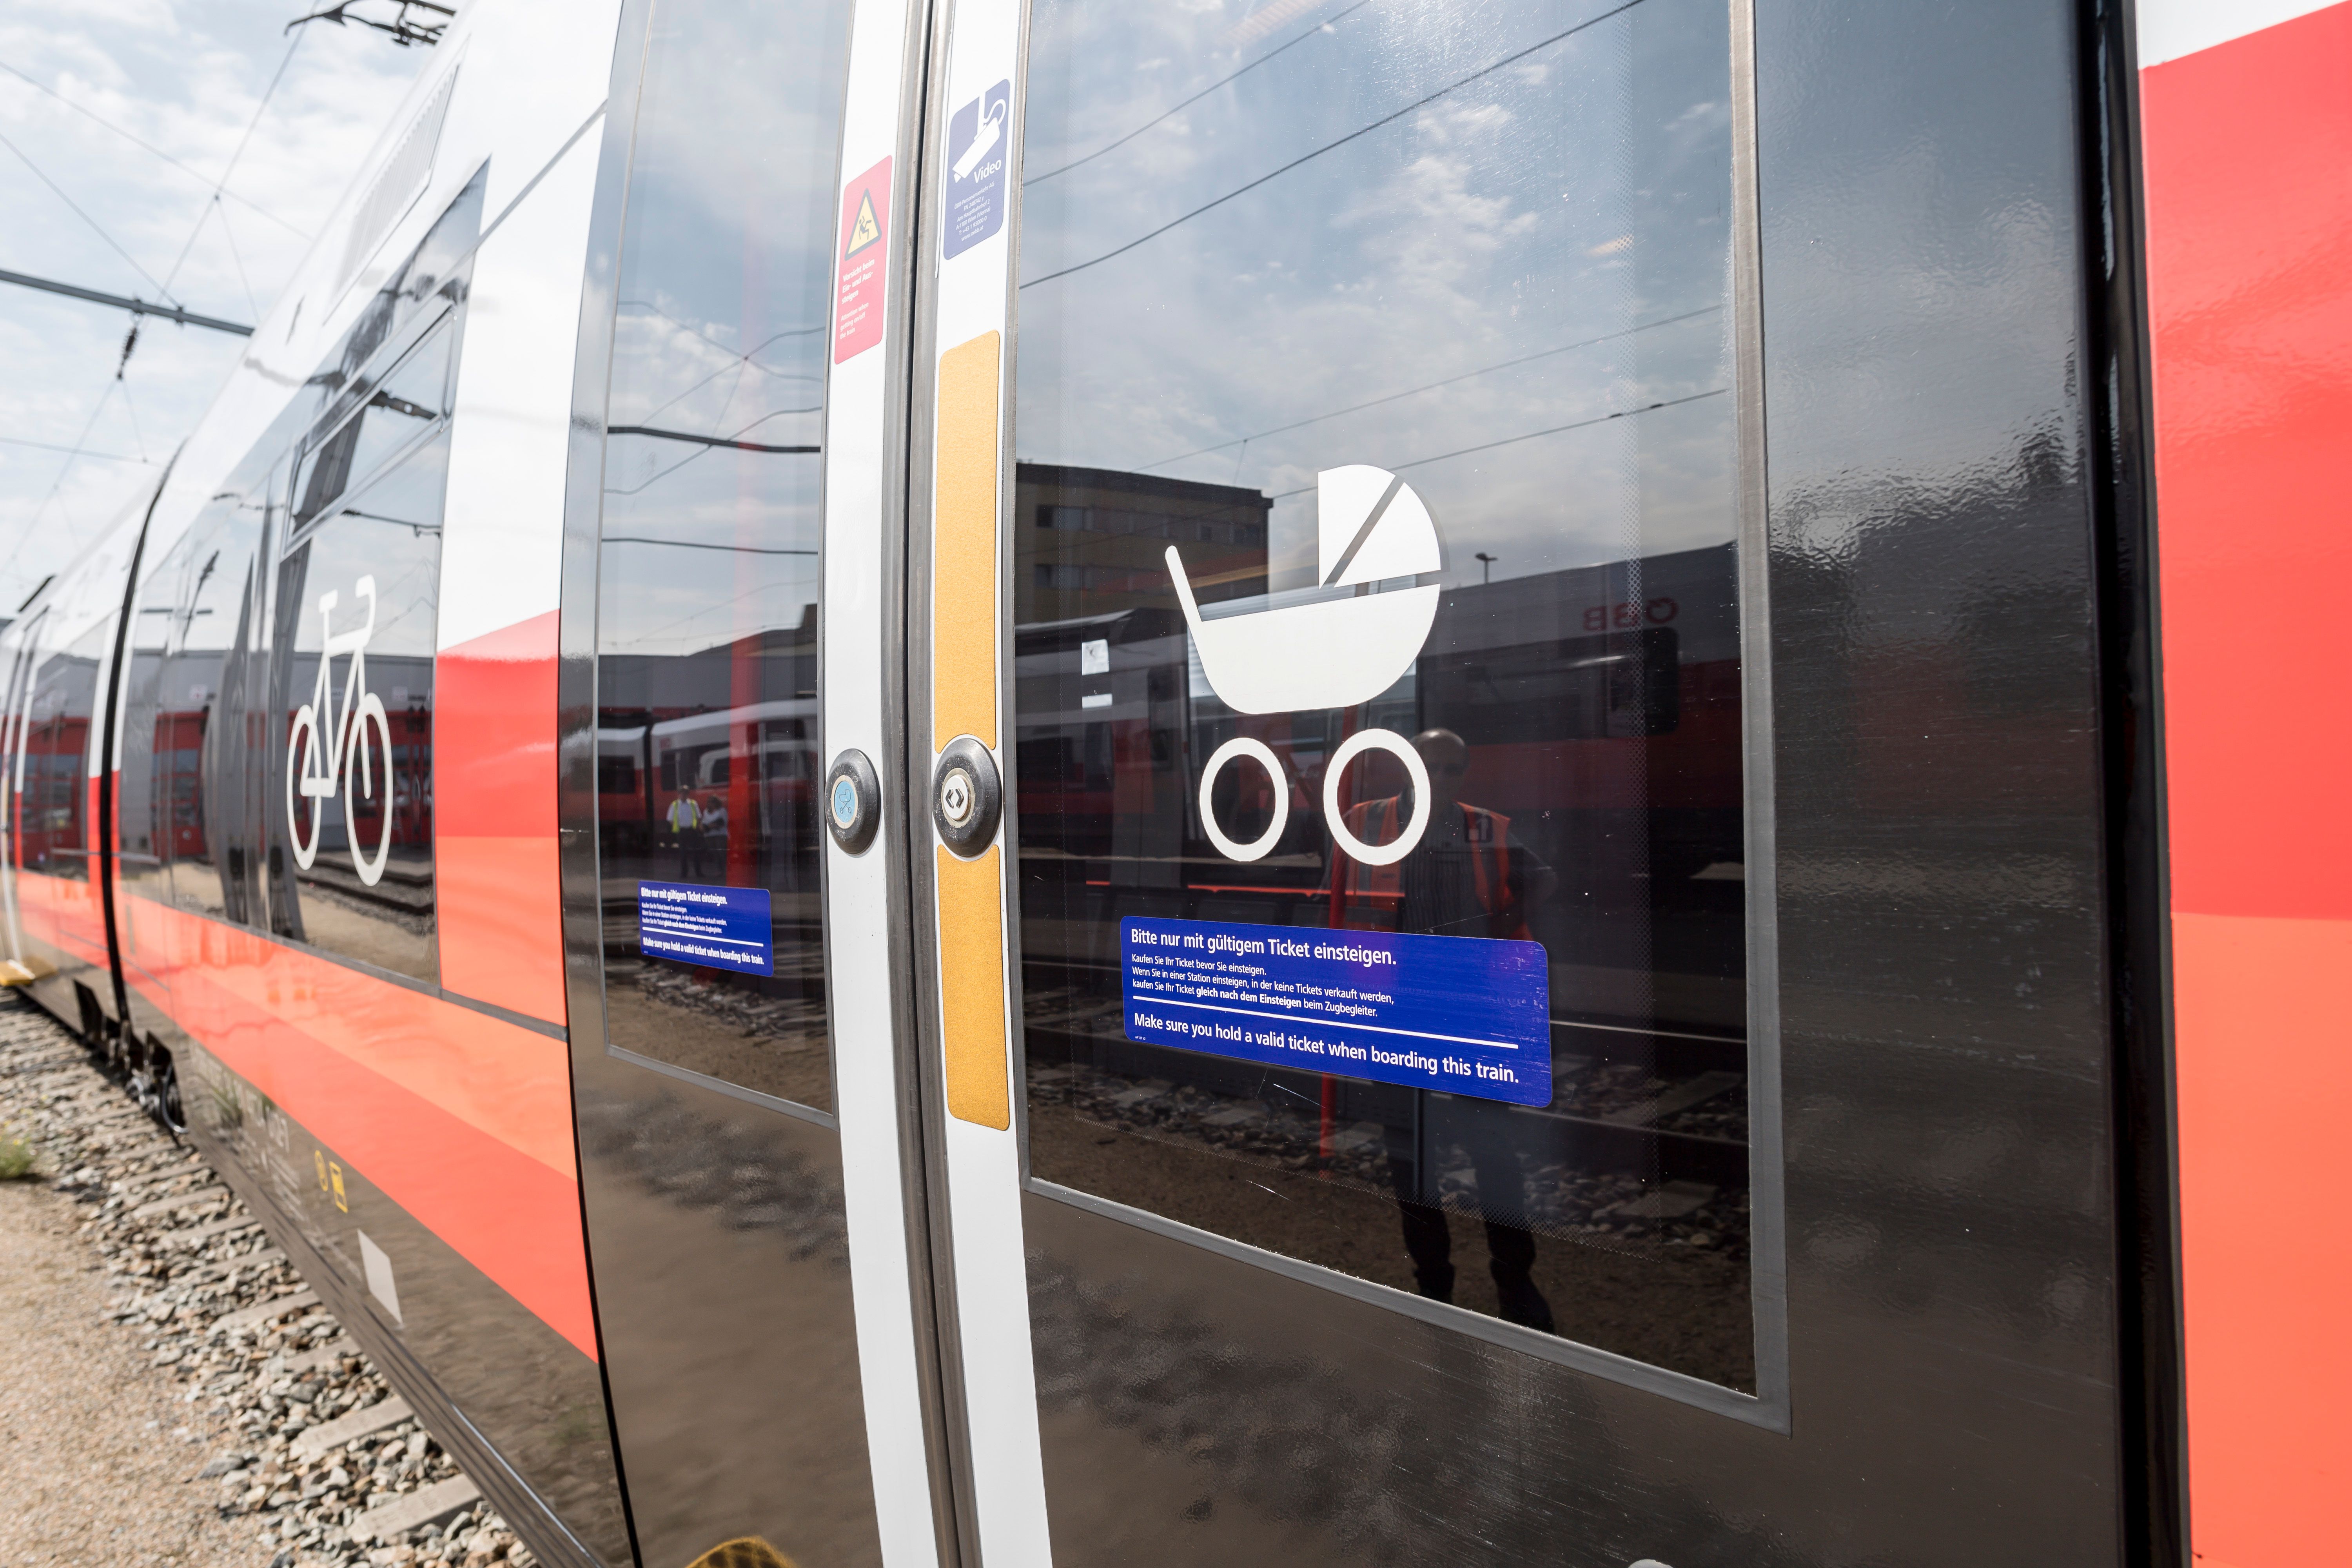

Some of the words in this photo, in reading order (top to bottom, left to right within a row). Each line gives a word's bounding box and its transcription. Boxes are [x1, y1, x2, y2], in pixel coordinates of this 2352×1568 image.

[974, 160, 1002, 183] Video
[843, 266, 862, 282] Vorsicht
[862, 259, 875, 270] beim
[842, 284, 851, 294] Ein-
[852, 275, 861, 287] und
[862, 271, 873, 282] Aus-
[842, 290, 859, 304] steigen
[841, 308, 858, 321] Attention
[858, 302, 869, 311] when
[840, 319, 853, 332] getting
[846, 327, 856, 336] train
[641, 887, 651, 897] Bitte
[667, 889, 686, 902] gültigem
[686, 891, 701, 902] Ticket
[701, 892, 728, 906] einsteigen.
[643, 937, 654, 947] Make
[662, 942, 671, 951] you
[671, 940, 680, 951] hold
[684, 944, 694, 954] valid
[694, 945, 707, 956] ticket
[707, 947, 720, 958] when
[720, 948, 741, 964] boarding
[741, 952, 751, 963] this
[751, 954, 764, 965] train.
[1131, 928, 1157, 945] Bitte
[1161, 934, 1181, 946] nur
[1184, 933, 1204, 949] mit
[1207, 934, 1264, 956] gültigem
[1267, 938, 1310, 958] Ticket
[1314, 942, 1396, 967] einsteigen.
[1132, 953, 1153, 964] Kaufen
[1154, 956, 1164, 965] Sie
[1165, 956, 1174, 966] Ihr
[1175, 957, 1195, 968] Ticket
[1196, 959, 1215, 970] bevor
[1216, 962, 1227, 971] Sie
[1229, 963, 1267, 976] einsteigen.
[1132, 966, 1150, 976] Wenn
[1151, 968, 1161, 978] Sie
[1162, 969, 1168, 978] in
[1169, 970, 1186, 980] einer
[1187, 972, 1210, 983] Station
[1212, 975, 1249, 989] einsteigen,
[1251, 978, 1258, 988] in
[1260, 979, 1272, 990] der
[1274, 980, 1294, 993] keine
[1295, 983, 1323, 996] Tickets
[1324, 987, 1358, 1000] verkauft
[1359, 991, 1394, 1005] werden,
[1132, 978, 1153, 989] kaufen
[1154, 981, 1164, 991] Sie
[1165, 982, 1174, 992] Ihr
[1175, 984, 1195, 995] Ticket
[1196, 986, 1218, 998] gleich
[1220, 990, 1238, 1000] nach
[1240, 991, 1258, 1002] dem
[1259, 993, 1302, 1009] Einsteigen
[1303, 998, 1323, 1010] beim
[1325, 1001, 1377, 1017] Zugbegleiter.
[1134, 1013, 1163, 1029] Make
[1165, 1020, 1189, 1033] sure
[1191, 1024, 1212, 1038] you
[1215, 1023, 1241, 1041] hold
[1245, 1032, 1252, 1043] a
[1255, 1031, 1285, 1048] valid
[1288, 1035, 1325, 1054] ticket
[1328, 1041, 1367, 1060] when
[1371, 1045, 1437, 1075] boarding
[1442, 1056, 1471, 1076] this
[1475, 1060, 1519, 1083] train.
